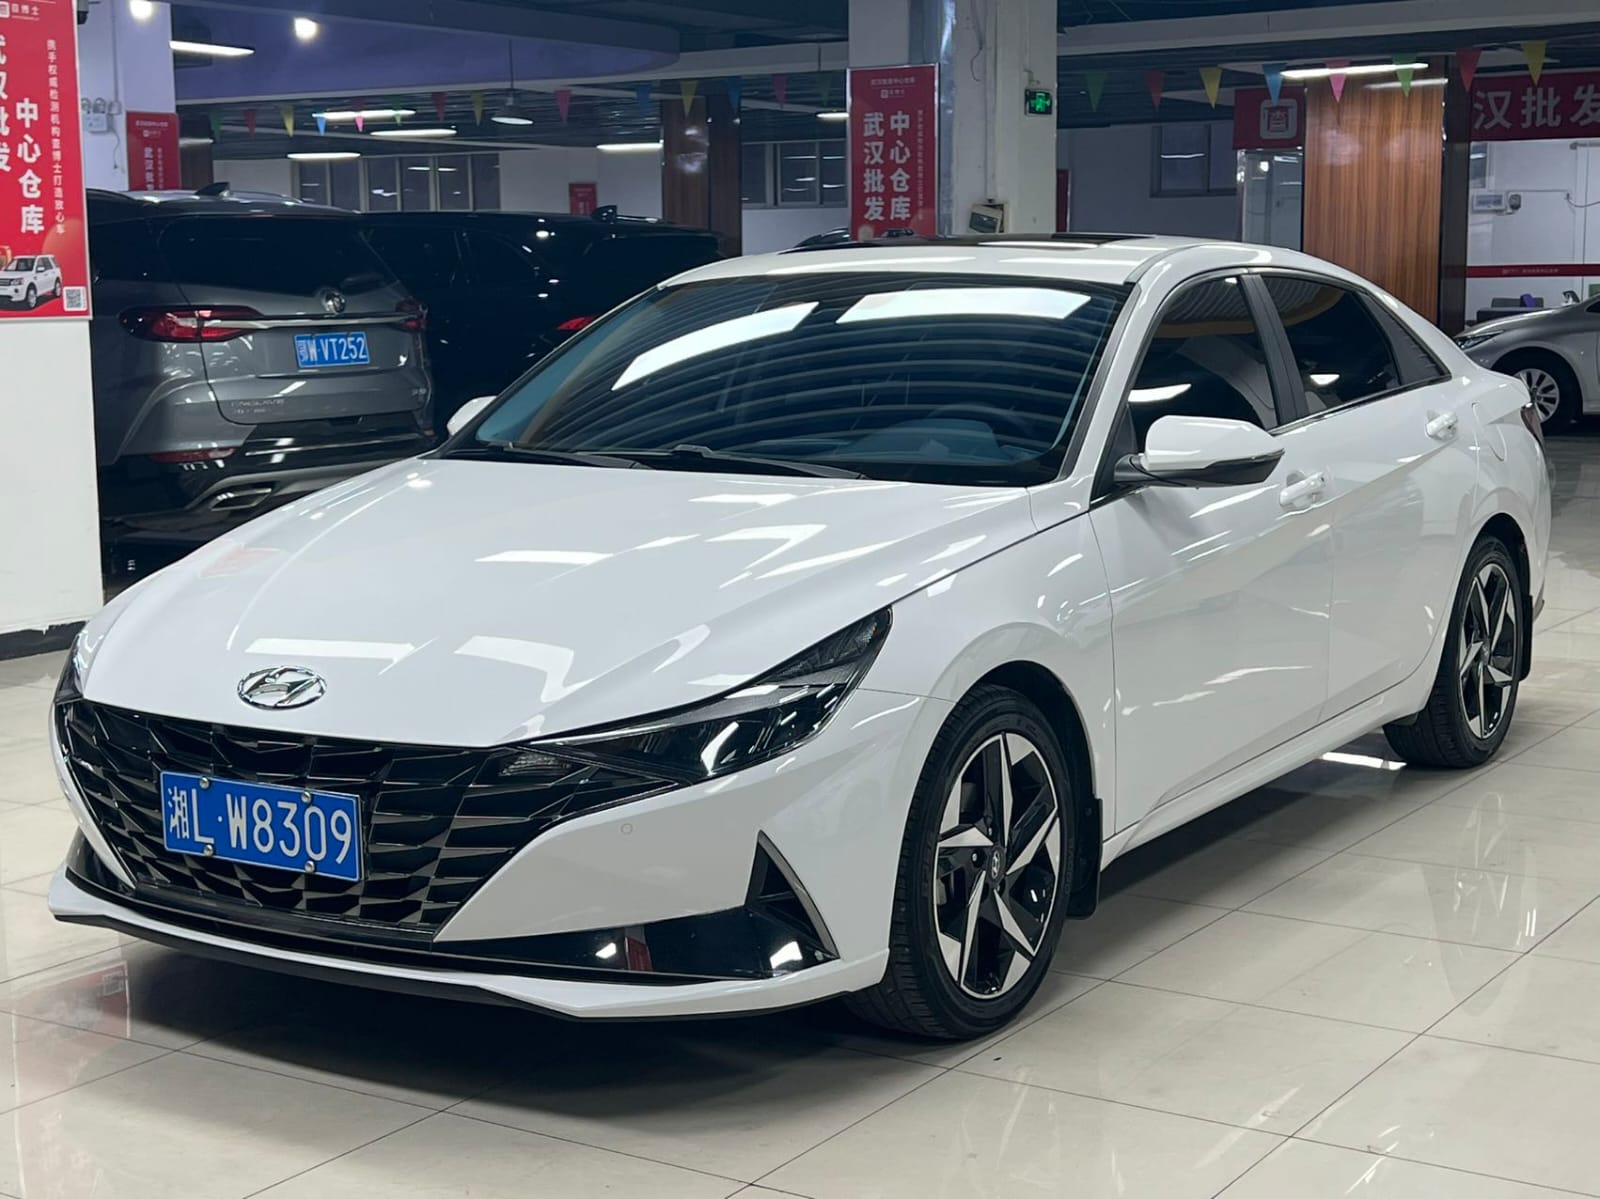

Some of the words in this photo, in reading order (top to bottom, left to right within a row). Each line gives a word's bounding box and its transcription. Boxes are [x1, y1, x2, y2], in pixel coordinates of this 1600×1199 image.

[15, 97, 45, 234] 中心仓库
[863, 111, 885, 222] 武汉批发
[889, 110, 912, 221] 中心仓库
[167, 785, 352, 865] 湘L·W8309
